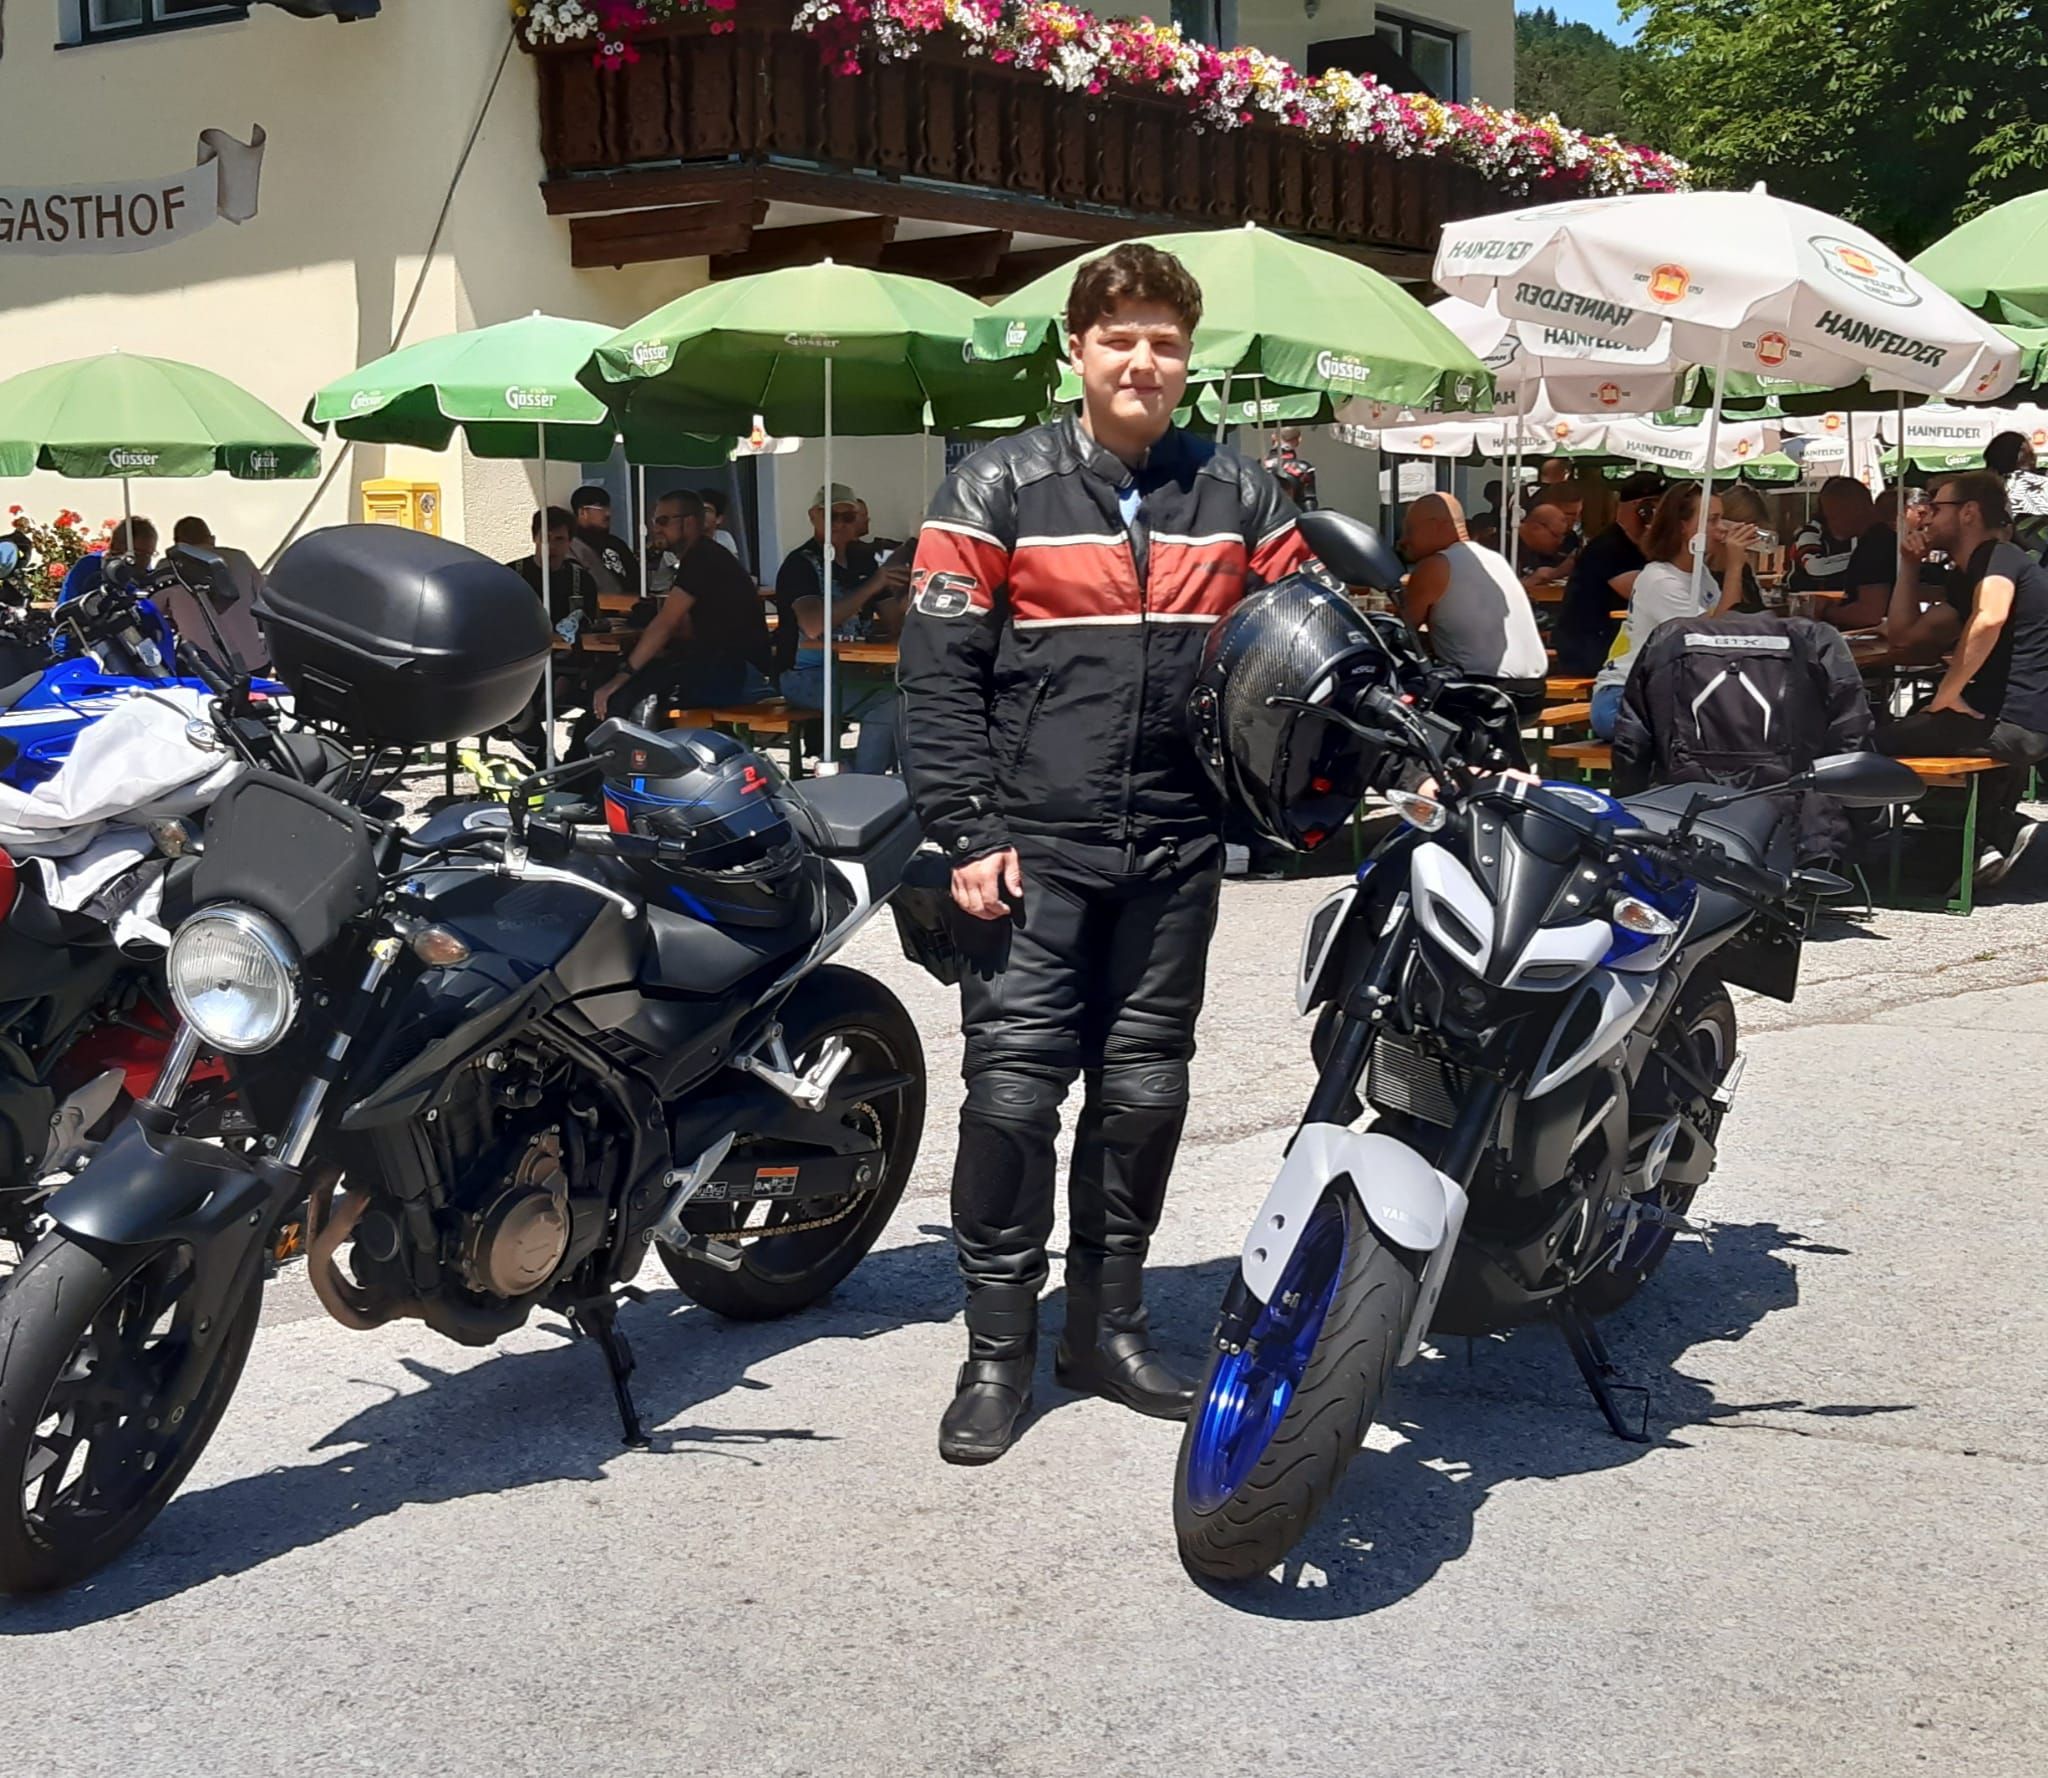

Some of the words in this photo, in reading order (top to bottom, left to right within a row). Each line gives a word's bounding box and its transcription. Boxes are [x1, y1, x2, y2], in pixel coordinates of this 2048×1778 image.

[1447, 241, 1533, 260] HAINFELDER
[1815, 309, 1948, 367] HAINFELDER
[633, 340, 669, 366] Gösser
[1317, 351, 1370, 379] Gösser
[505, 385, 557, 409] Gösser
[1907, 425, 1981, 439] HAINFELDER
[109, 447, 159, 468] Gösser
[1626, 440, 1693, 460] HAINFELDER
